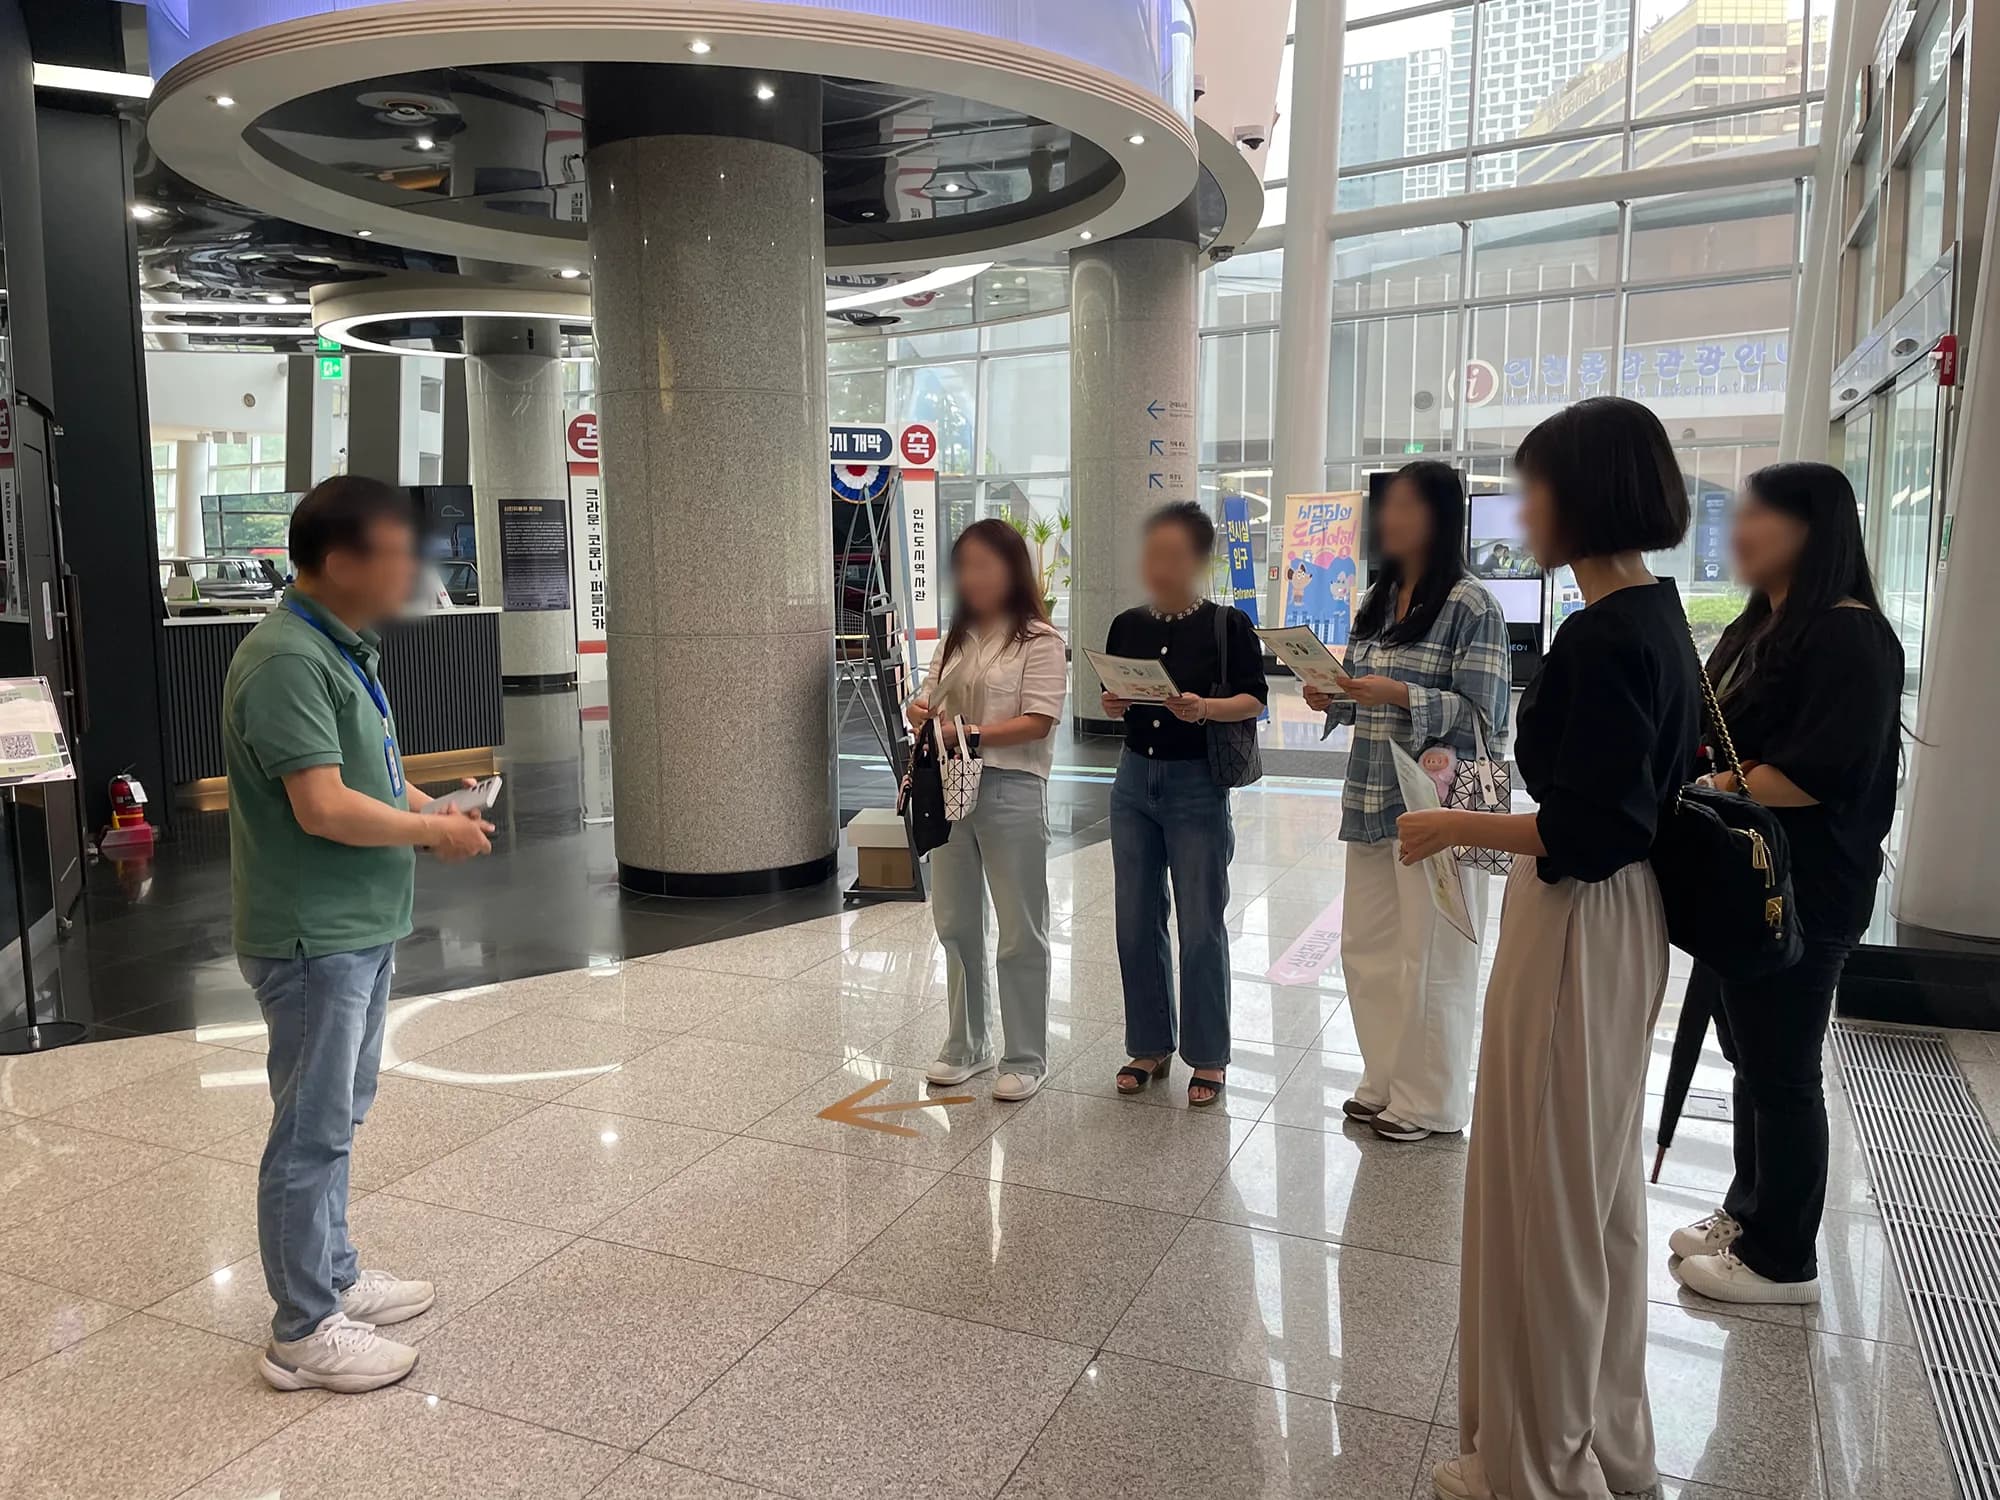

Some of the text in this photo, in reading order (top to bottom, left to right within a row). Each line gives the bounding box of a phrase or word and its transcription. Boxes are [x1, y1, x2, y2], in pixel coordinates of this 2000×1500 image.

[852, 433, 882, 453] 개막
[907, 432, 930, 458] 축
[1298, 503, 1353, 536] 시골쥐의
[1227, 520, 1250, 543] 전시실
[912, 508, 927, 602] 인천도시역사관
[1233, 547, 1248, 570] 입구
[1233, 587, 1256, 600] Entrance
